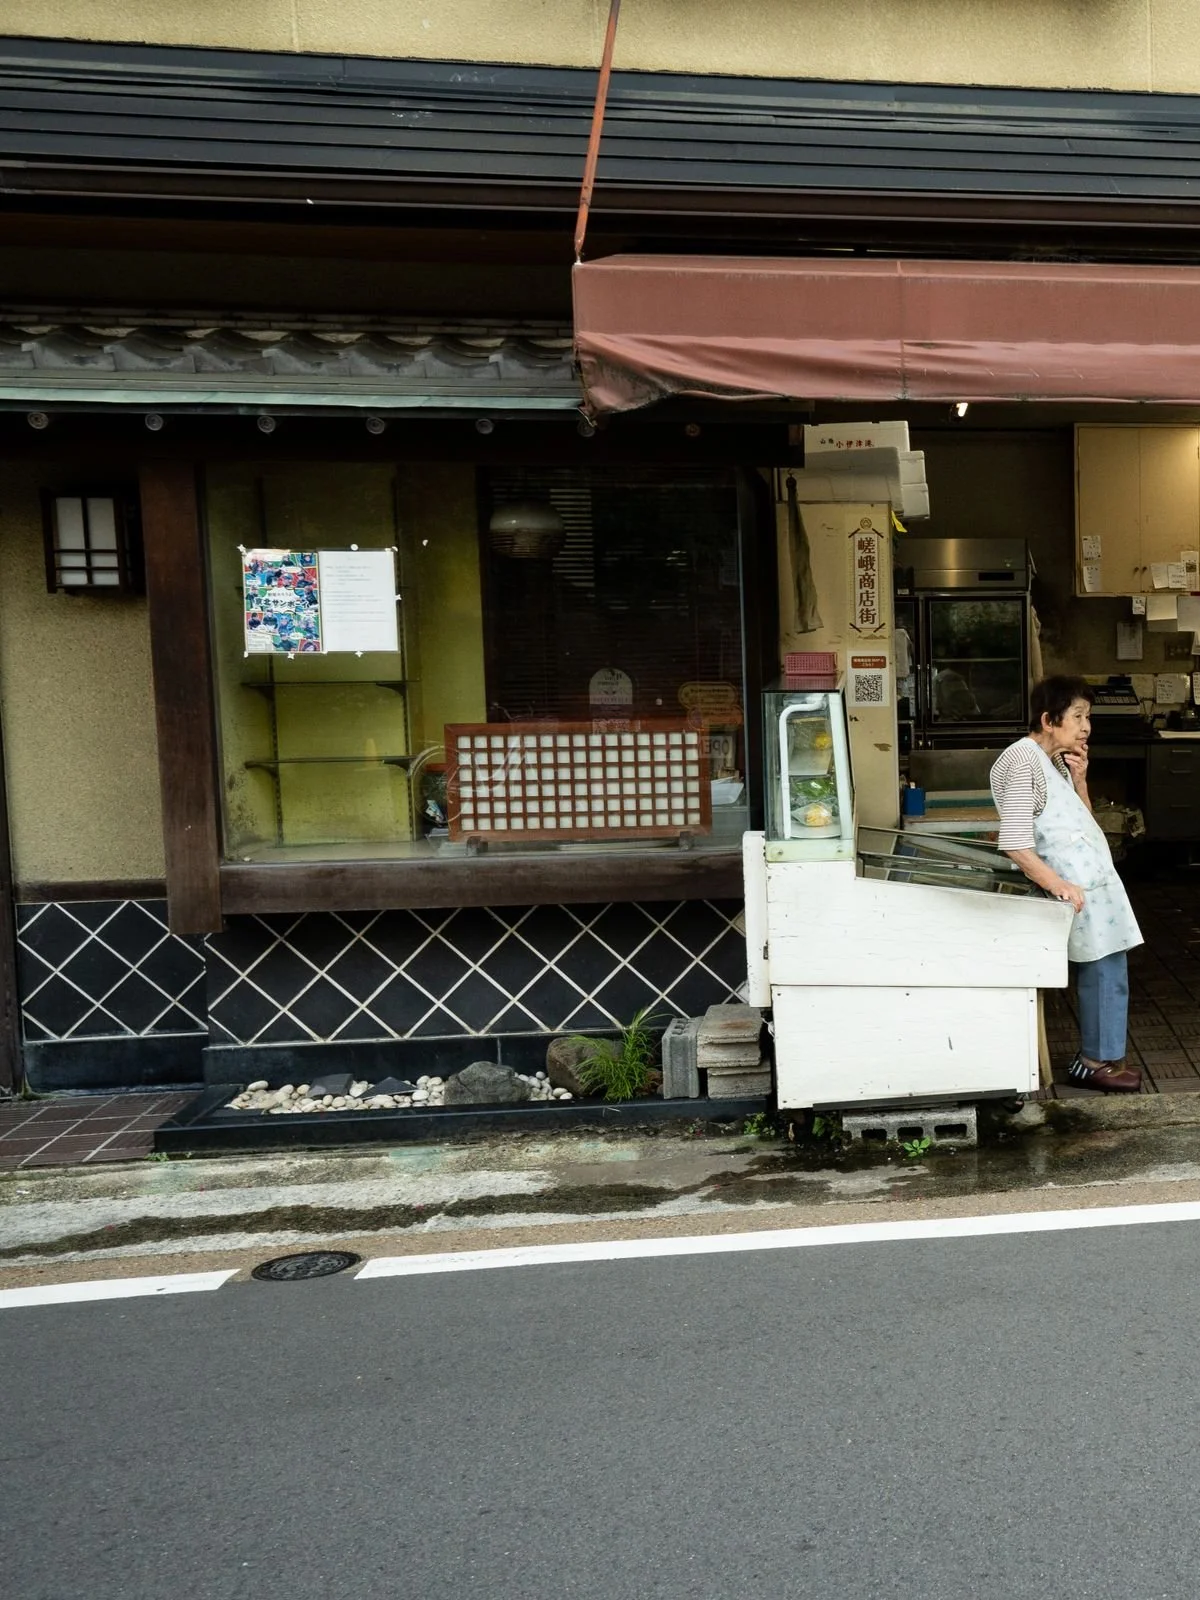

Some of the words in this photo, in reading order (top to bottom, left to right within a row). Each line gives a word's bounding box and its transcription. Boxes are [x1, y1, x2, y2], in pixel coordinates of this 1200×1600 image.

[857, 537, 877, 625] 嵯峨商店街
